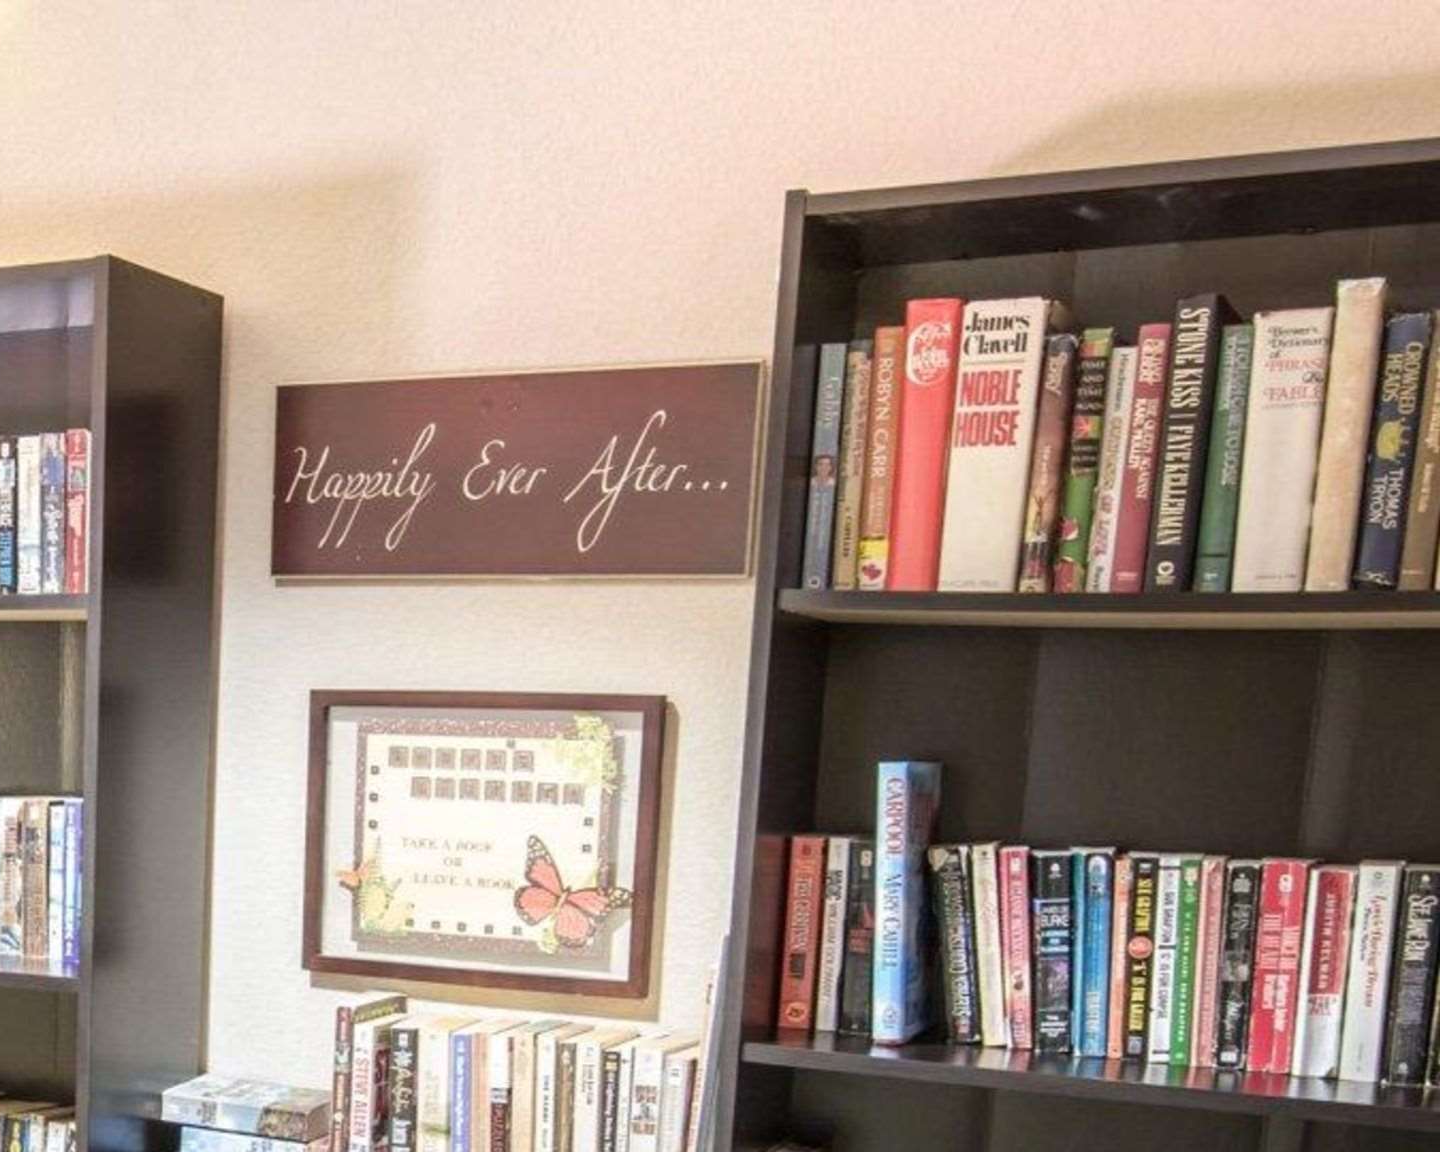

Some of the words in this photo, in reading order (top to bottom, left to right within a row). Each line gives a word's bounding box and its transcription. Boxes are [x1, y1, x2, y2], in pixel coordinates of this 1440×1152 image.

[963, 332, 1028, 356] Clavell
[965, 312, 1031, 333] James
[1177, 307, 1211, 365] STONE
[873, 357, 894, 422] ROBYN
[959, 369, 1022, 407] NOBLE
[1170, 368, 1204, 409] KISS
[1381, 353, 1404, 402] HEADS
[1398, 342, 1425, 416] CROWNED
[954, 409, 1019, 448] HOUSE
[1163, 425, 1194, 462] FAYE
[870, 427, 889, 480] CARR
[284, 422, 438, 552] Happily
[463, 439, 547, 503] Ever
[563, 409, 730, 552] After...
[1368, 475, 1389, 523] TRYON
[1381, 468, 1405, 530] THOMAS
[1155, 464, 1189, 547] KELLERMAN
[884, 777, 906, 857] CARPOOL
[439, 839, 451, 850] A
[881, 873, 904, 914] MARY
[1321, 893, 1336, 937] JUDITH
[880, 916, 903, 970] CAHILL
[353, 1057, 370, 1098] STEVE
[351, 1099, 368, 1138] ALLEN
